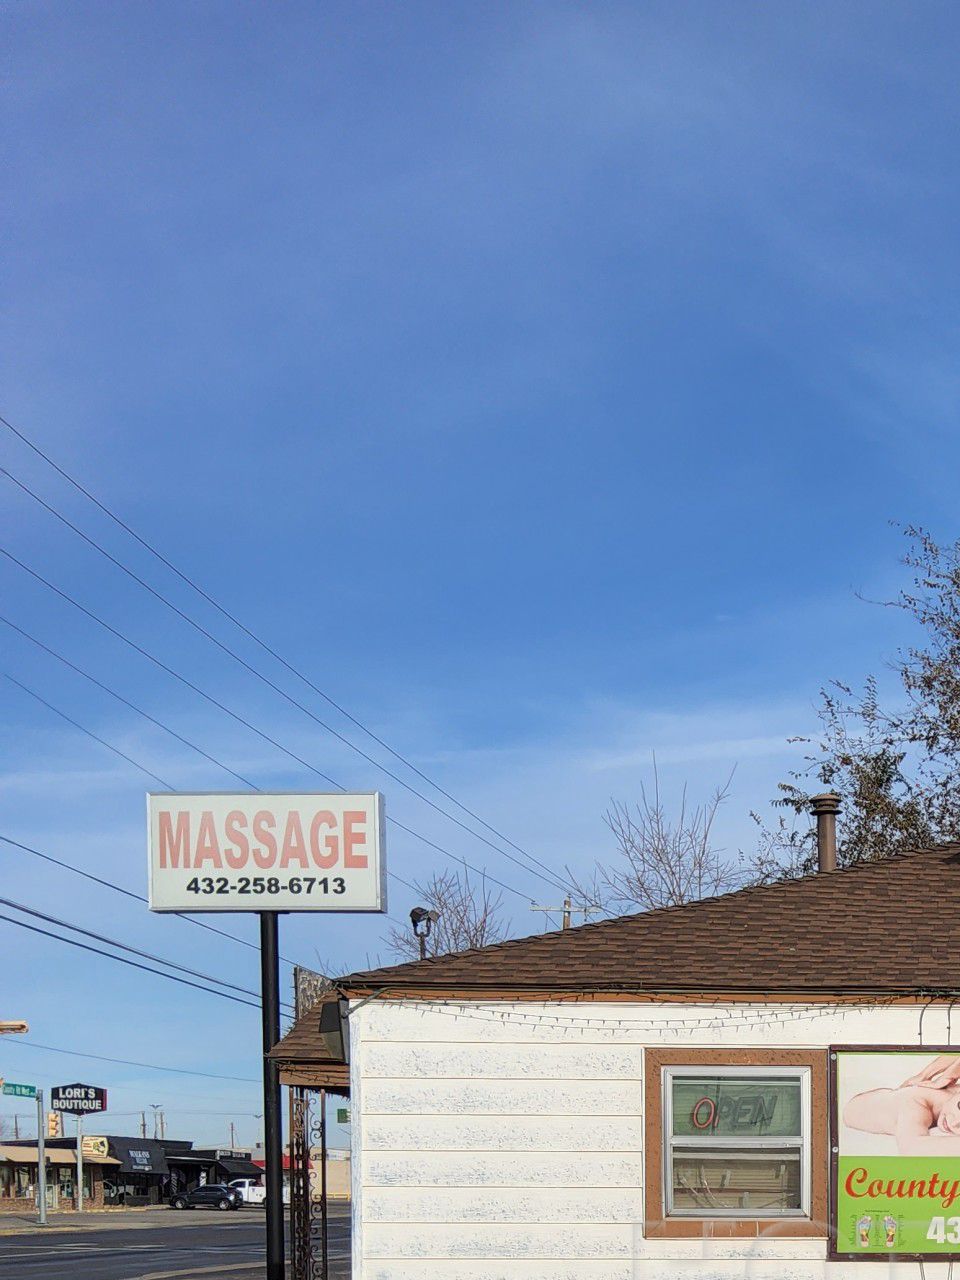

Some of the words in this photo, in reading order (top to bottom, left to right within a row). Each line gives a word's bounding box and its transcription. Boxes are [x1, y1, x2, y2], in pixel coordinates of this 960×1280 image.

[159, 810, 368, 870] MASSAGE
[186, 877, 346, 895] 432-258-6713
[58, 1088, 96, 1099] LORI'S
[53, 1100, 102, 1110] BOUTIQUE
[692, 1096, 778, 1129] OPEN
